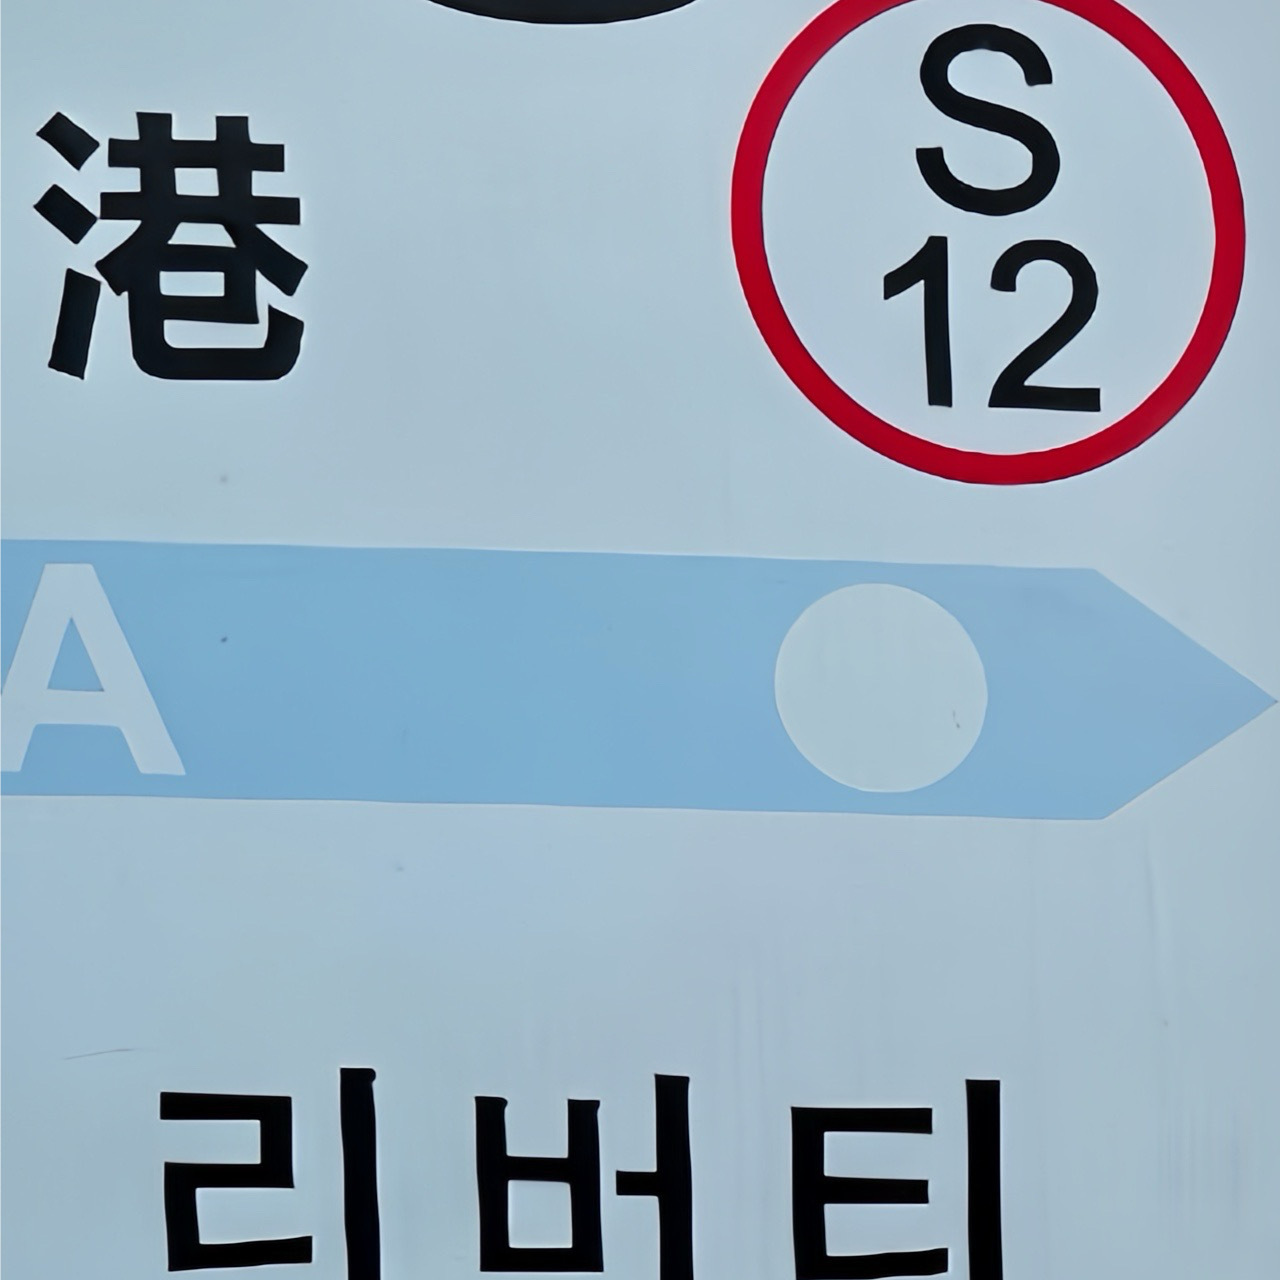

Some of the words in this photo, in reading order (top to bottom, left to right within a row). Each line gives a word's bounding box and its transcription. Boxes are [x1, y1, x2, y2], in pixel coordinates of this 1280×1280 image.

[915, 23, 1061, 217] S
[33, 111, 309, 381] 港
[883, 235, 1101, 413] 12
[0, 563, 186, 776] A
